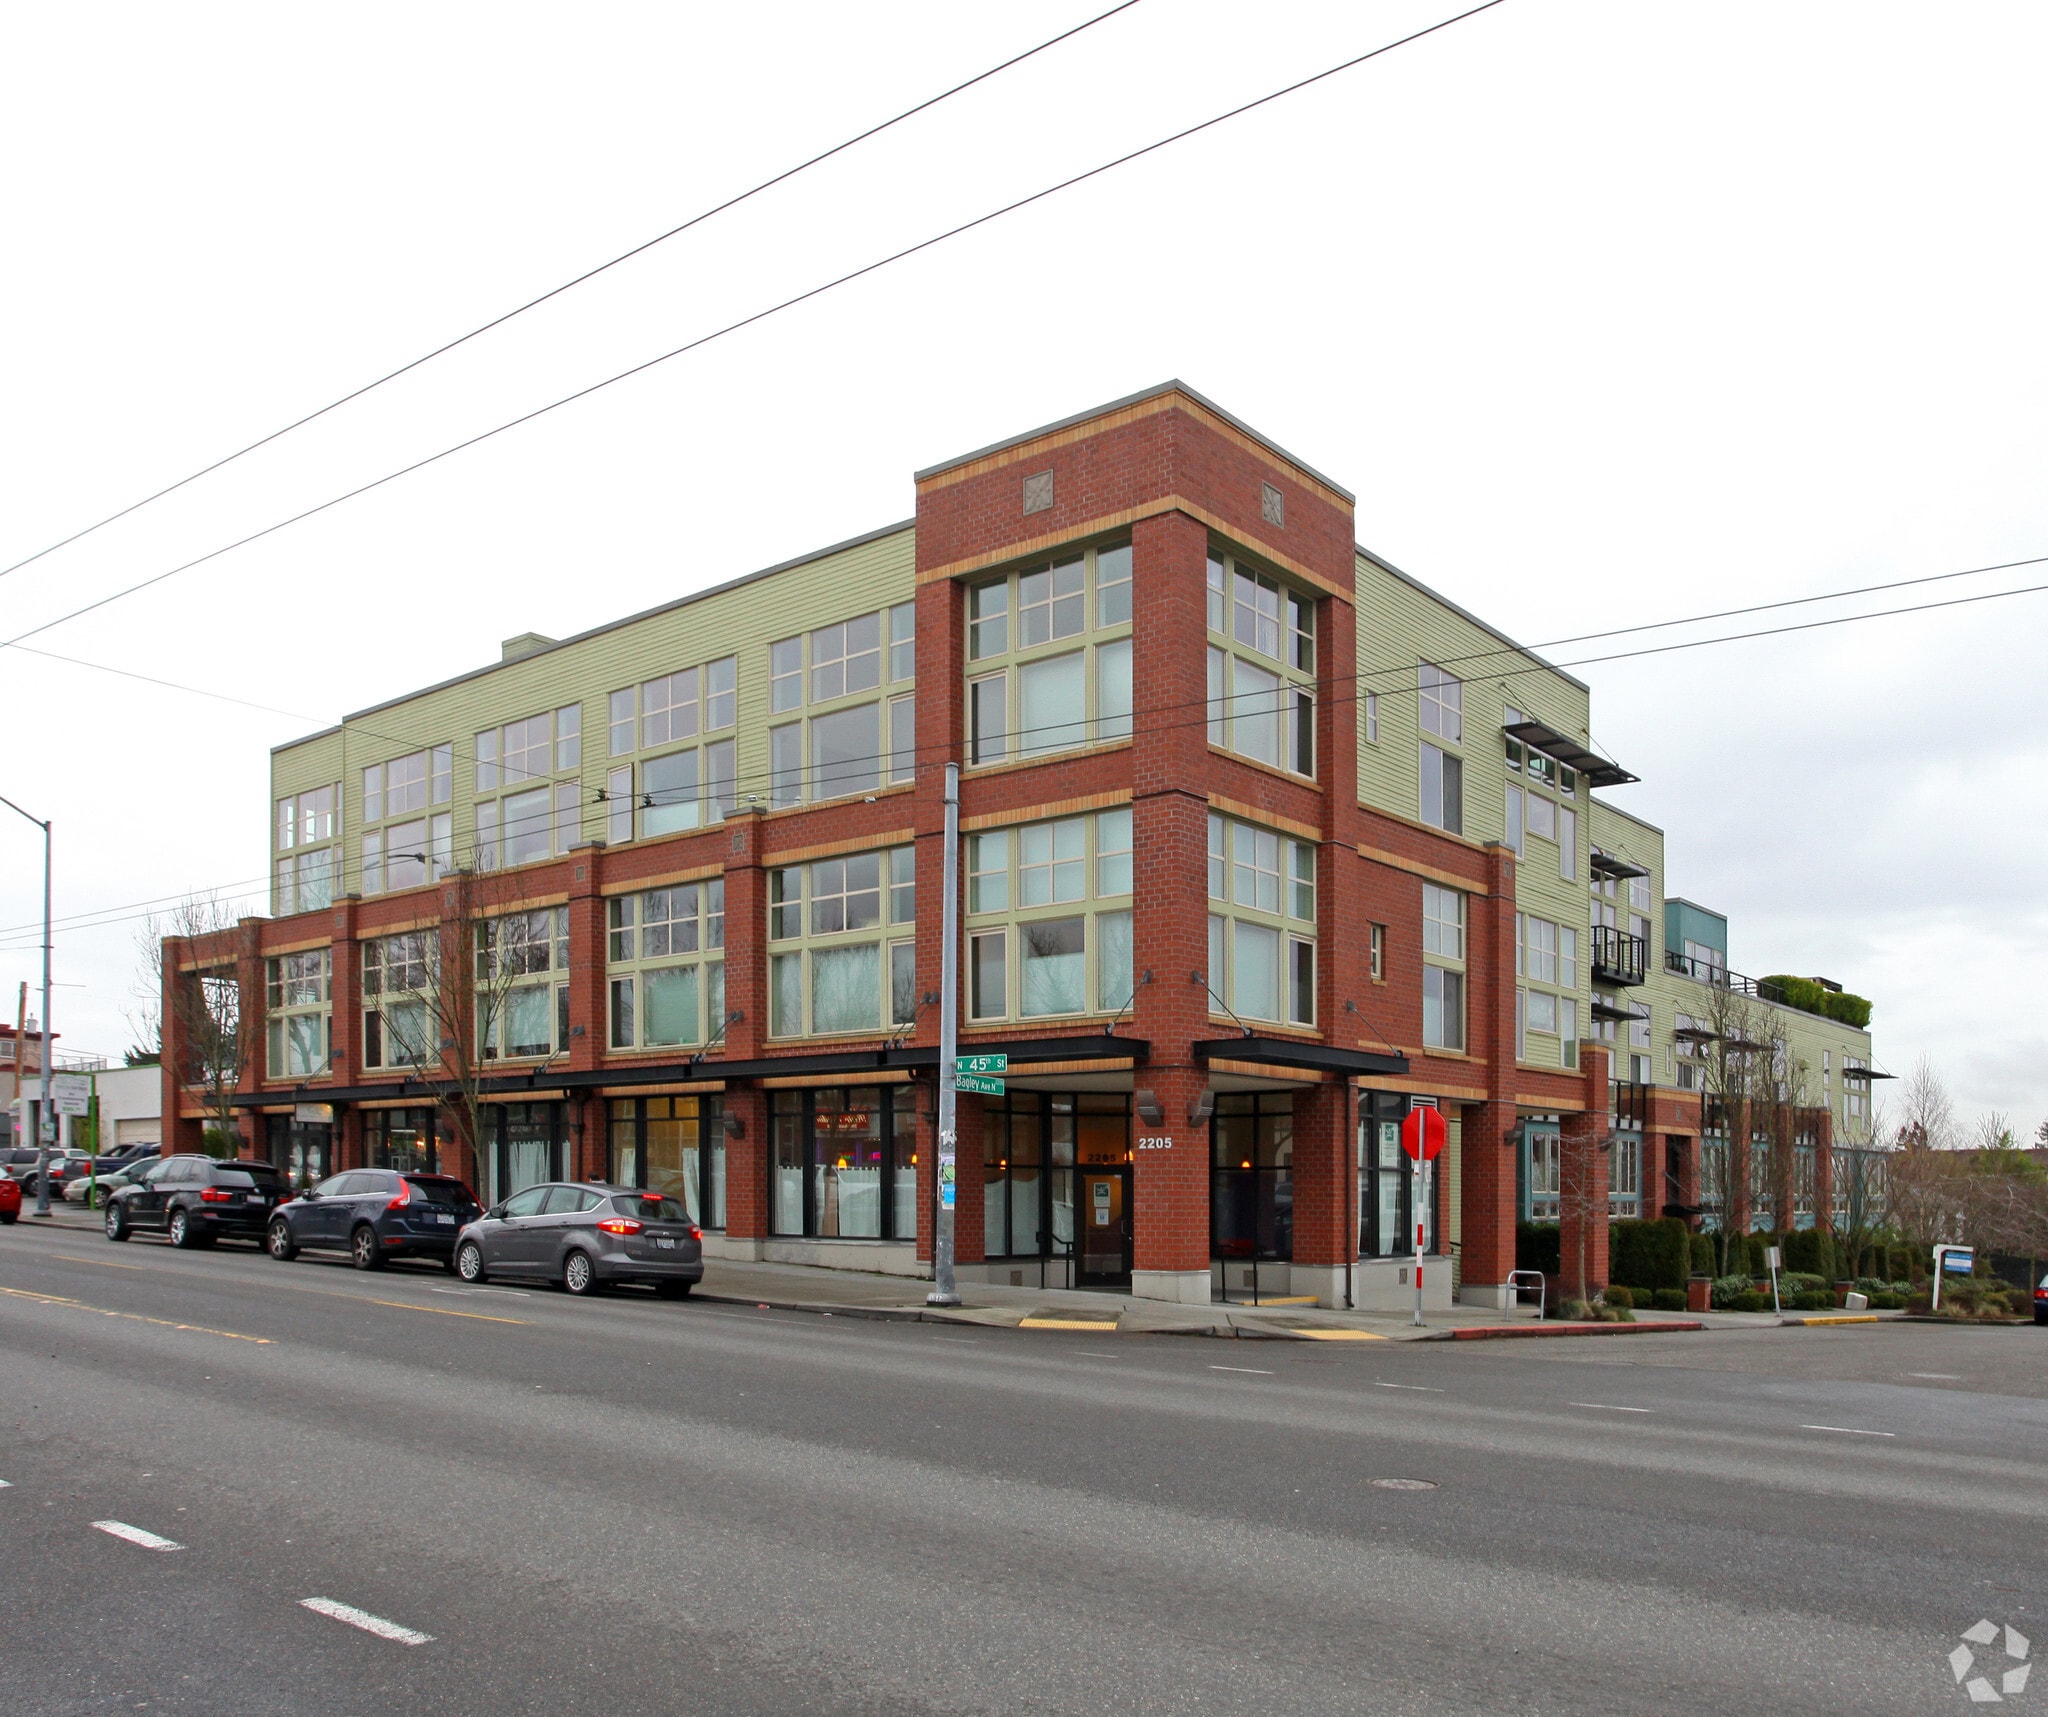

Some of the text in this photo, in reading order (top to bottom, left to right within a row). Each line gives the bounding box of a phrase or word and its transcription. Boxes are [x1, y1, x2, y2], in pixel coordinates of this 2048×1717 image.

[957, 1057, 1004, 1070] N 45th St
[957, 1074, 979, 1091] Bagley
[981, 1082, 990, 1091] Ave
[991, 1083, 996, 1091] N
[1138, 1137, 1172, 1149] 2205
[1088, 1153, 1116, 1163] 2205
